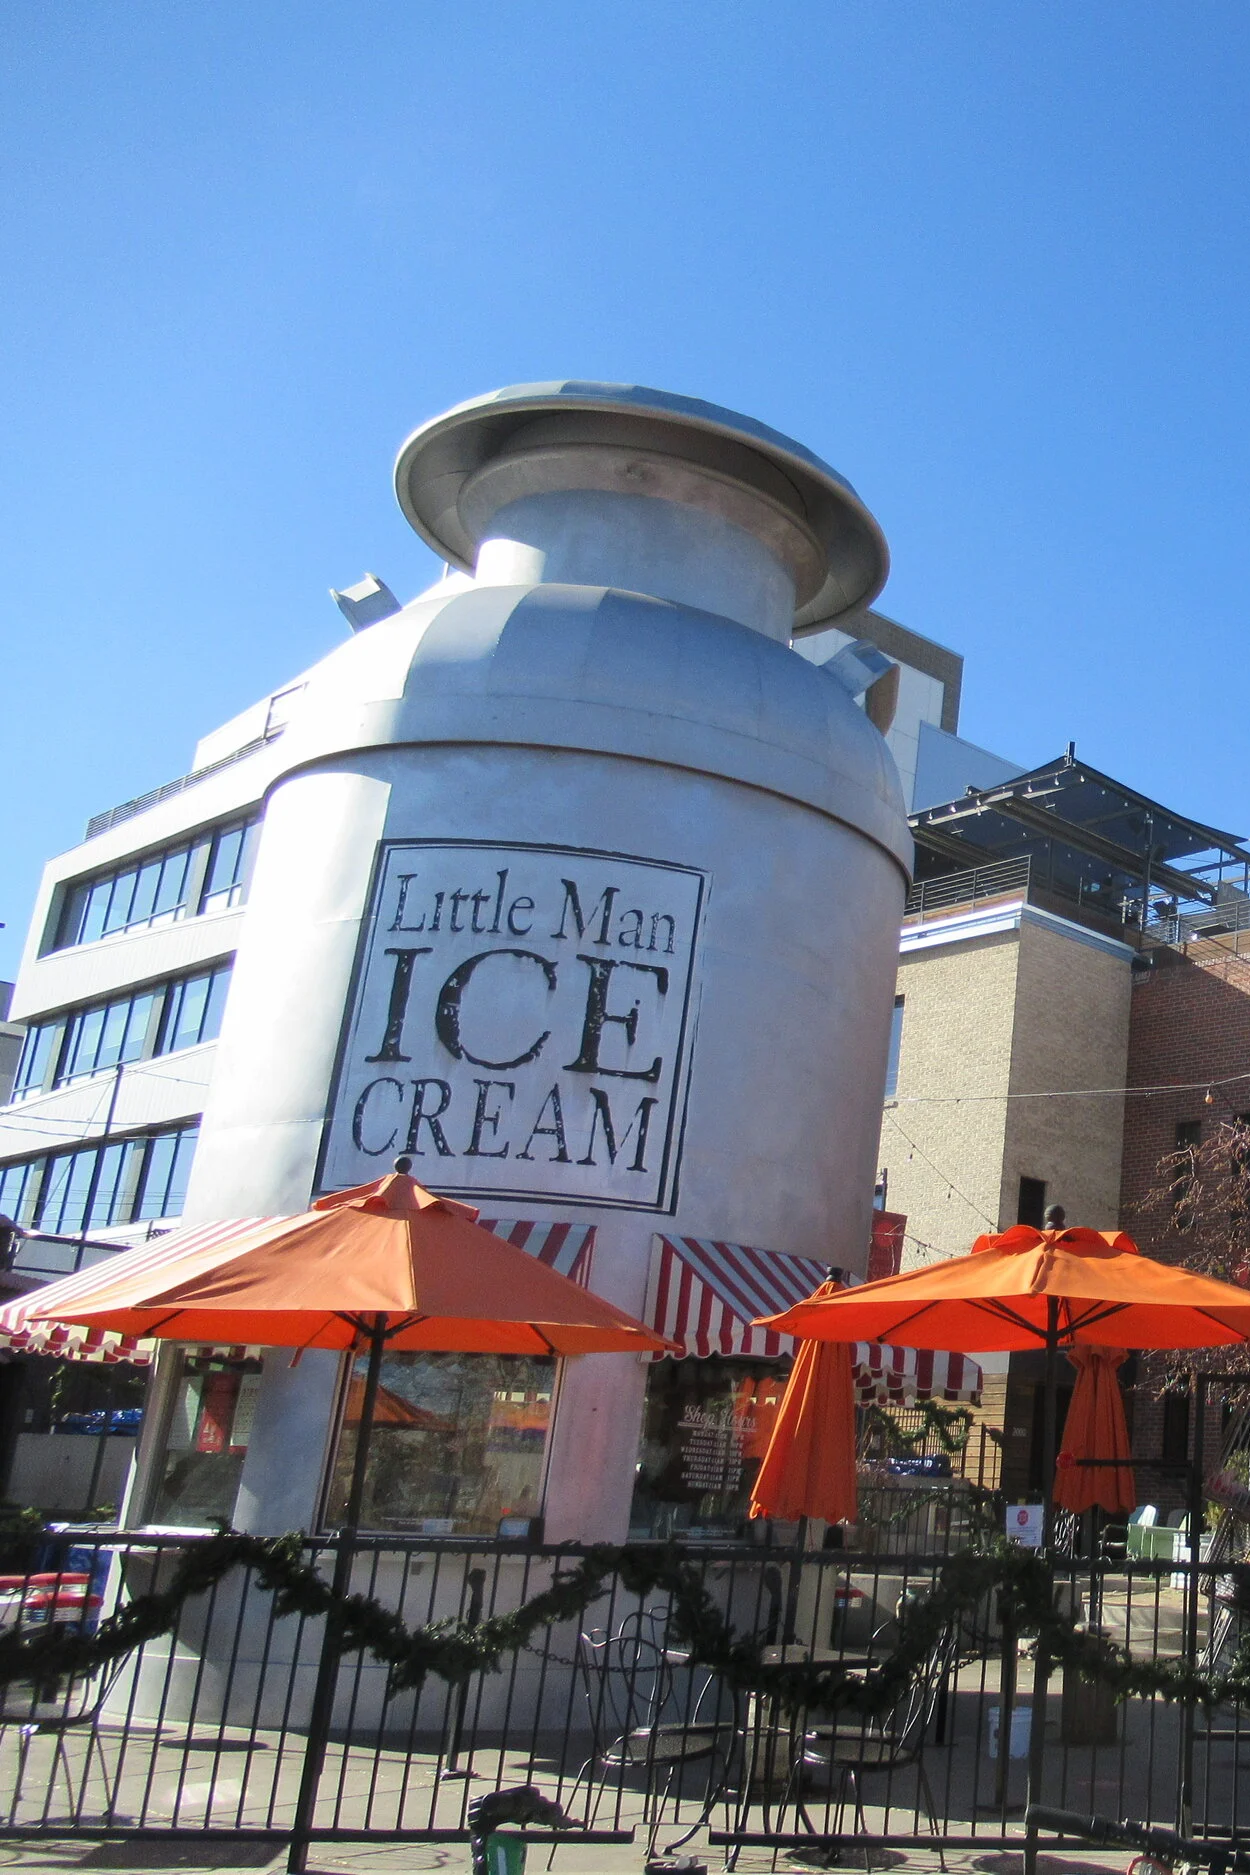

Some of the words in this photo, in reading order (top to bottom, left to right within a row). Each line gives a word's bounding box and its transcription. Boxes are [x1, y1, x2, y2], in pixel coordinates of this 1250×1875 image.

[387, 868, 535, 936] Little
[550, 878, 676, 954] Man
[365, 947, 669, 1083] ICE
[352, 1077, 660, 1173] CREAM
[684, 1405, 715, 1430] Shop
